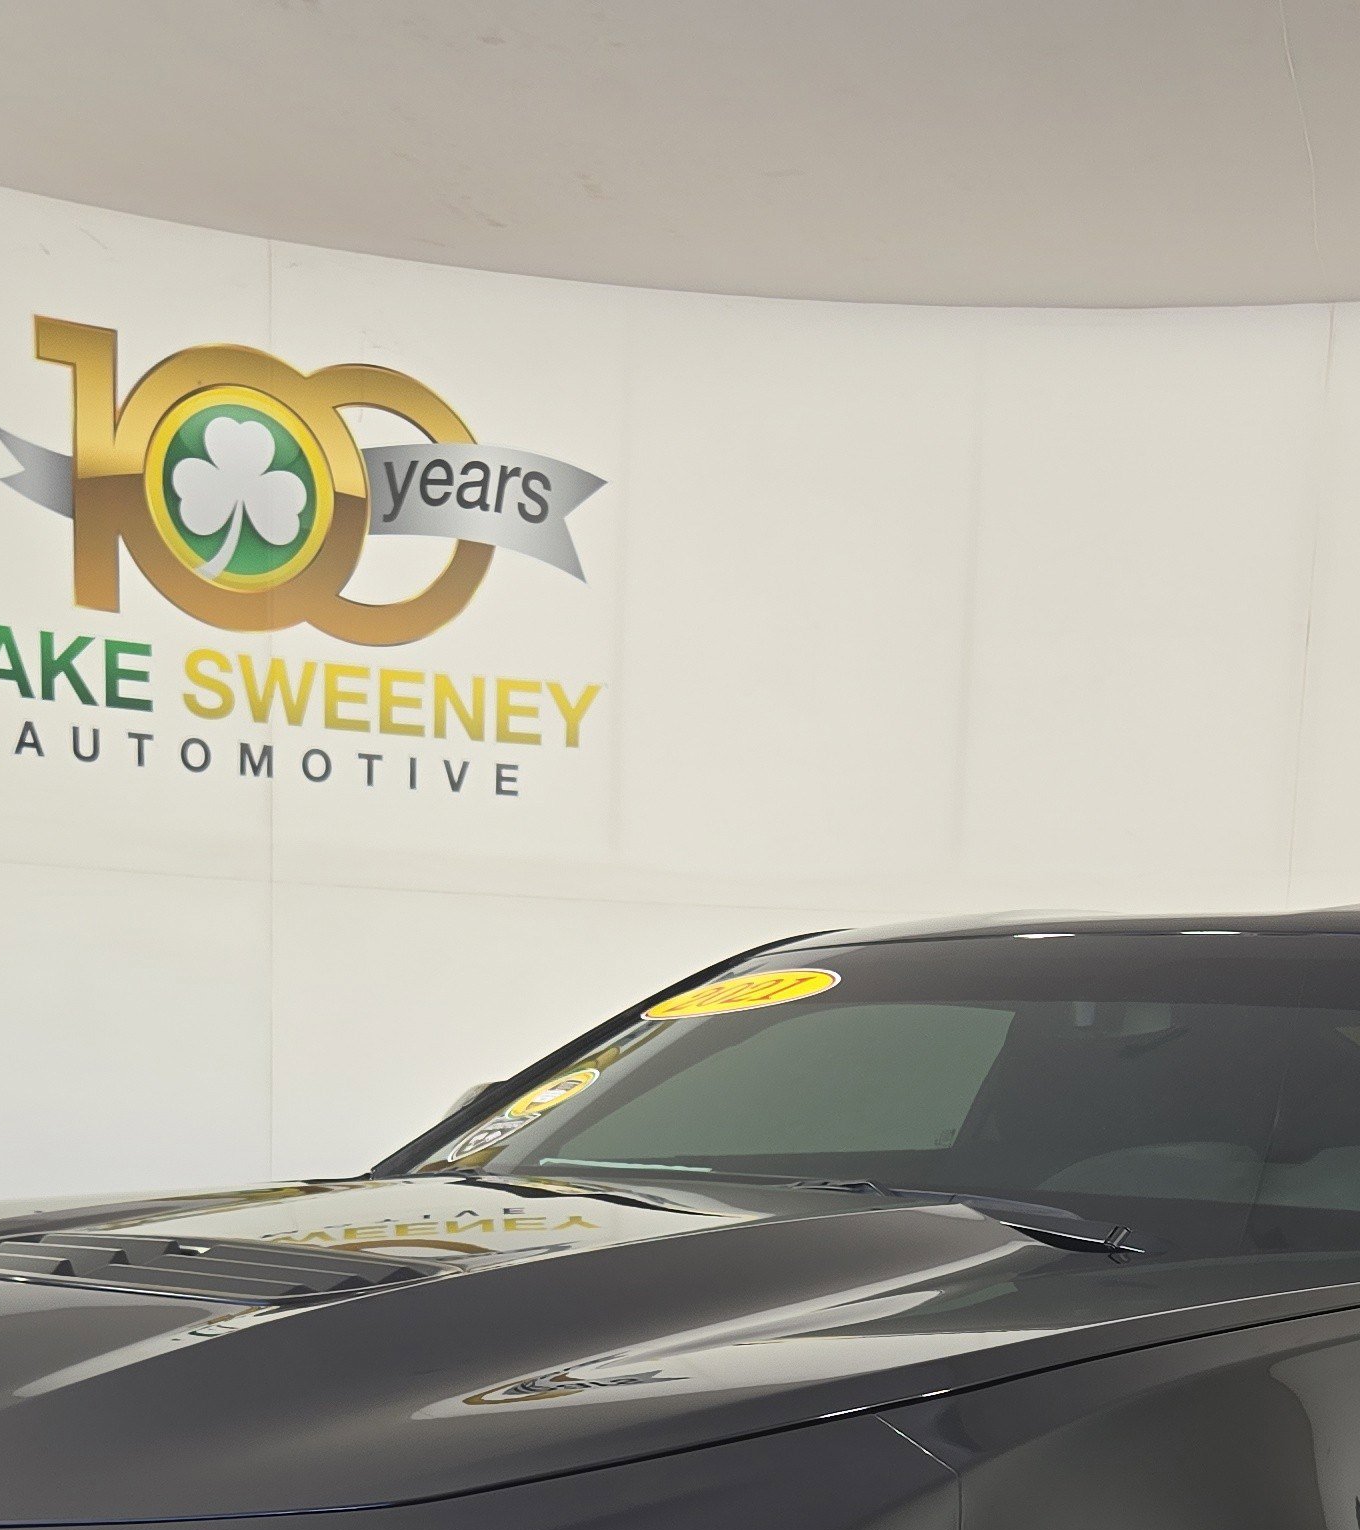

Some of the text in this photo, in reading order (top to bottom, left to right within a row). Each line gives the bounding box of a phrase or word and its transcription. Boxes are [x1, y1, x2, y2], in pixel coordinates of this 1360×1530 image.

[381, 456, 552, 524] years
[181, 649, 601, 748] SWEENEY
[13, 720, 520, 797] AUTOMOTIVE
